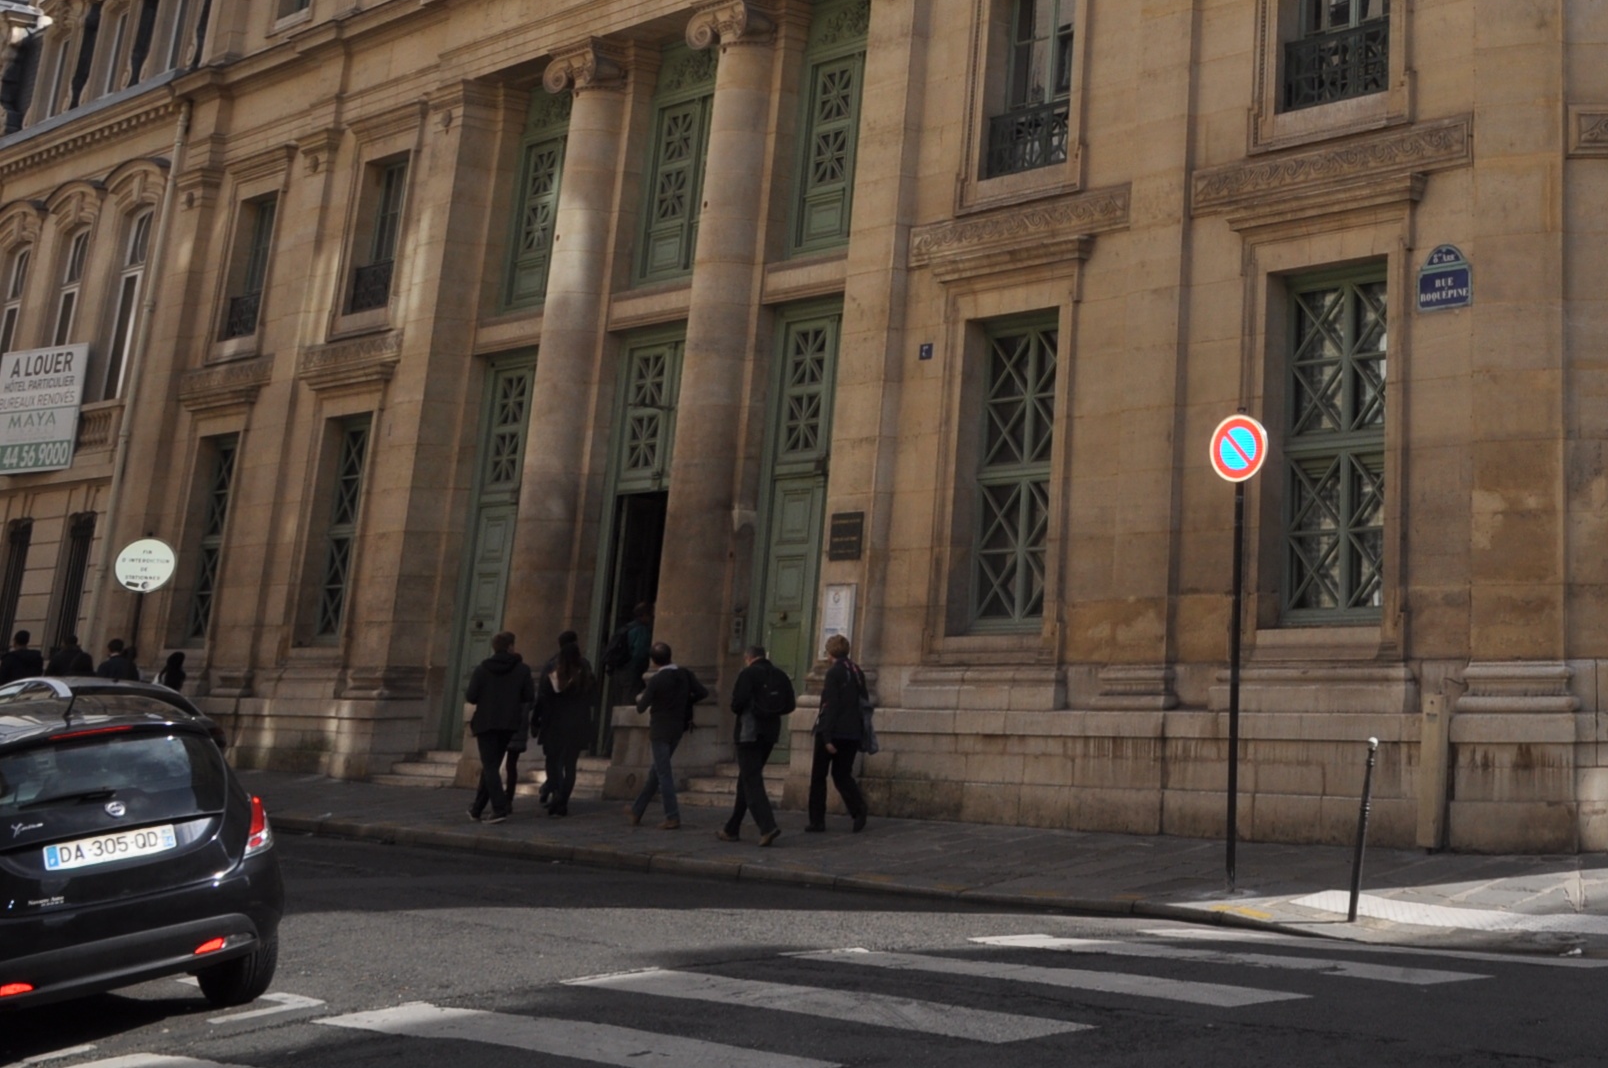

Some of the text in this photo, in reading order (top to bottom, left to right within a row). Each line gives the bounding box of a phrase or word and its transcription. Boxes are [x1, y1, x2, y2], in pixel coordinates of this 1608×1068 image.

[1435, 277, 1453, 288] RUE
[1420, 288, 1469, 302] ROQUÉPINE
[10, 351, 74, 378] A LOUER
[4, 375, 75, 393] HÔTEL PARTICULIER
[7, 411, 57, 429] MAYA
[2, 441, 69, 468] 44 56 9000
